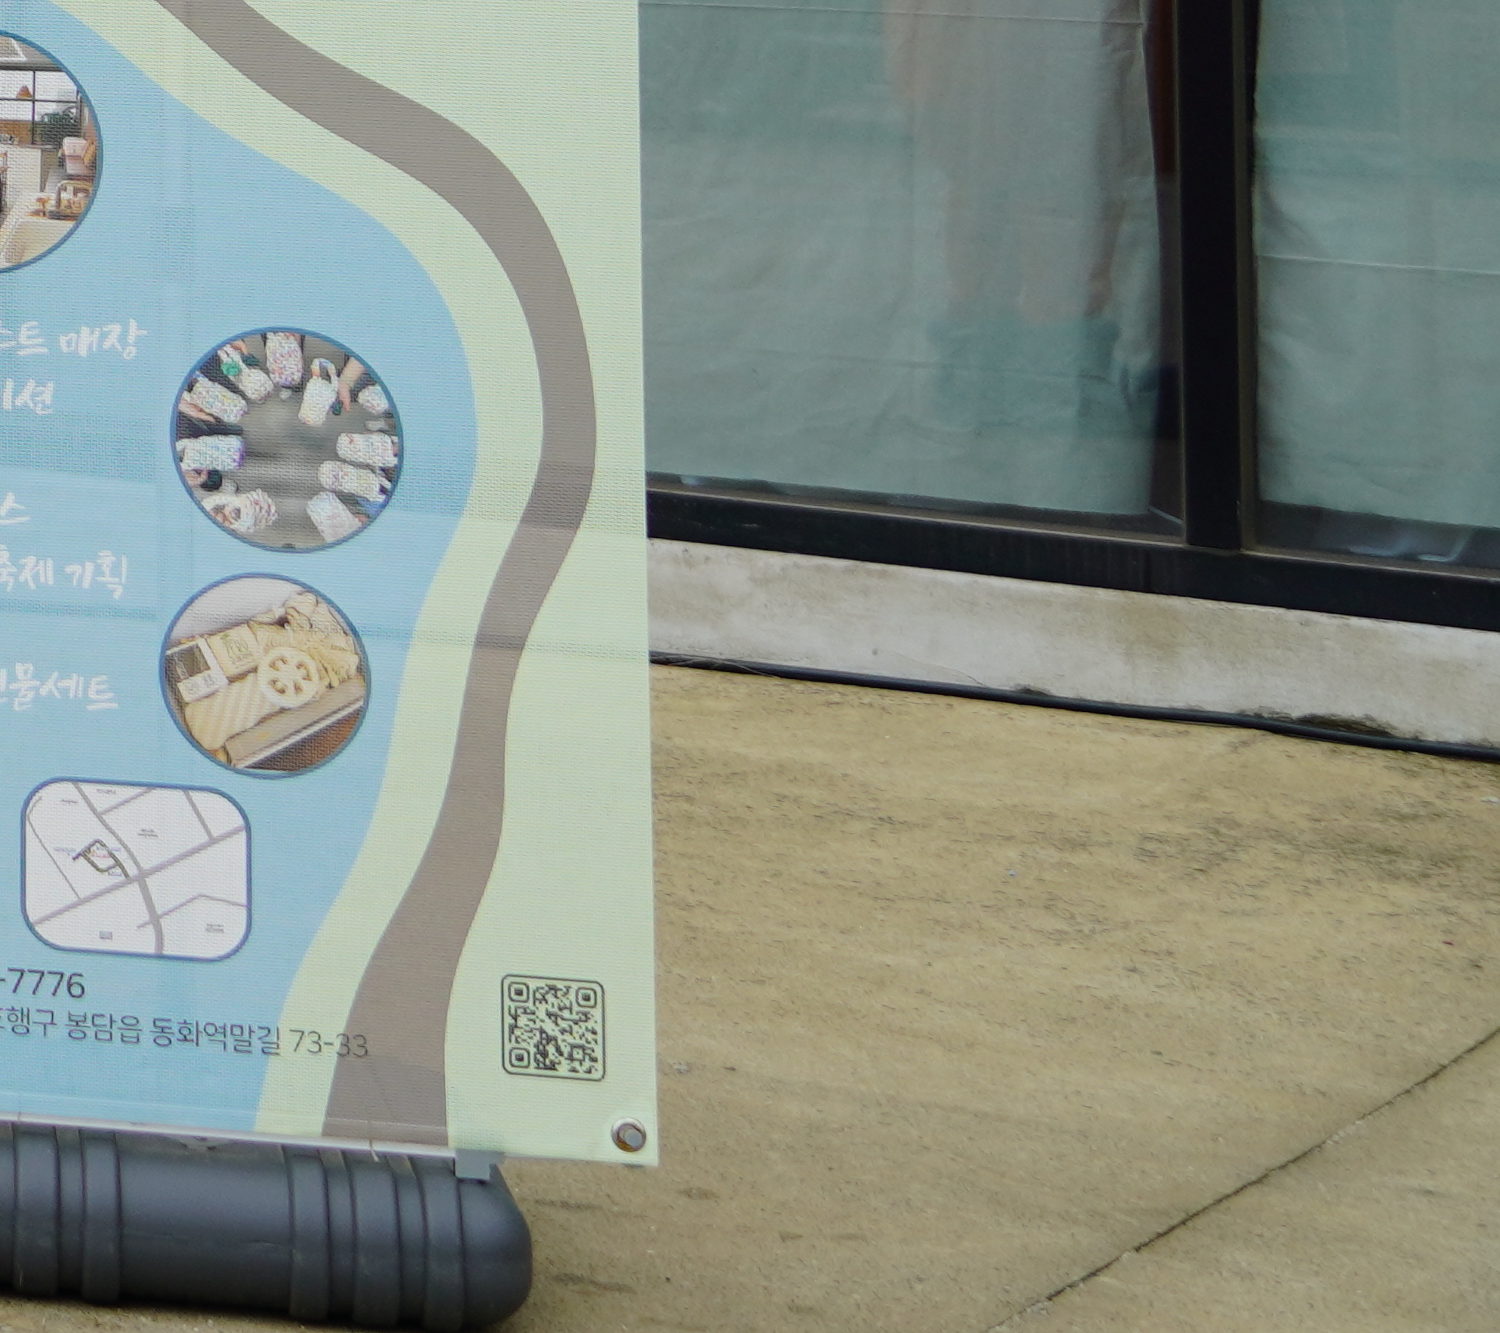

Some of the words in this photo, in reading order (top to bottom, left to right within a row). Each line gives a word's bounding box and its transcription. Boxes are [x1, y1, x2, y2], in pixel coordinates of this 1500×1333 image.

[59, 317, 148, 360] 매장
[65, 549, 128, 600] 기획
[65, 1011, 142, 1044] 봉담읍
[150, 1017, 281, 1056] 동화역말길
[289, 1029, 368, 1058] 73-33
